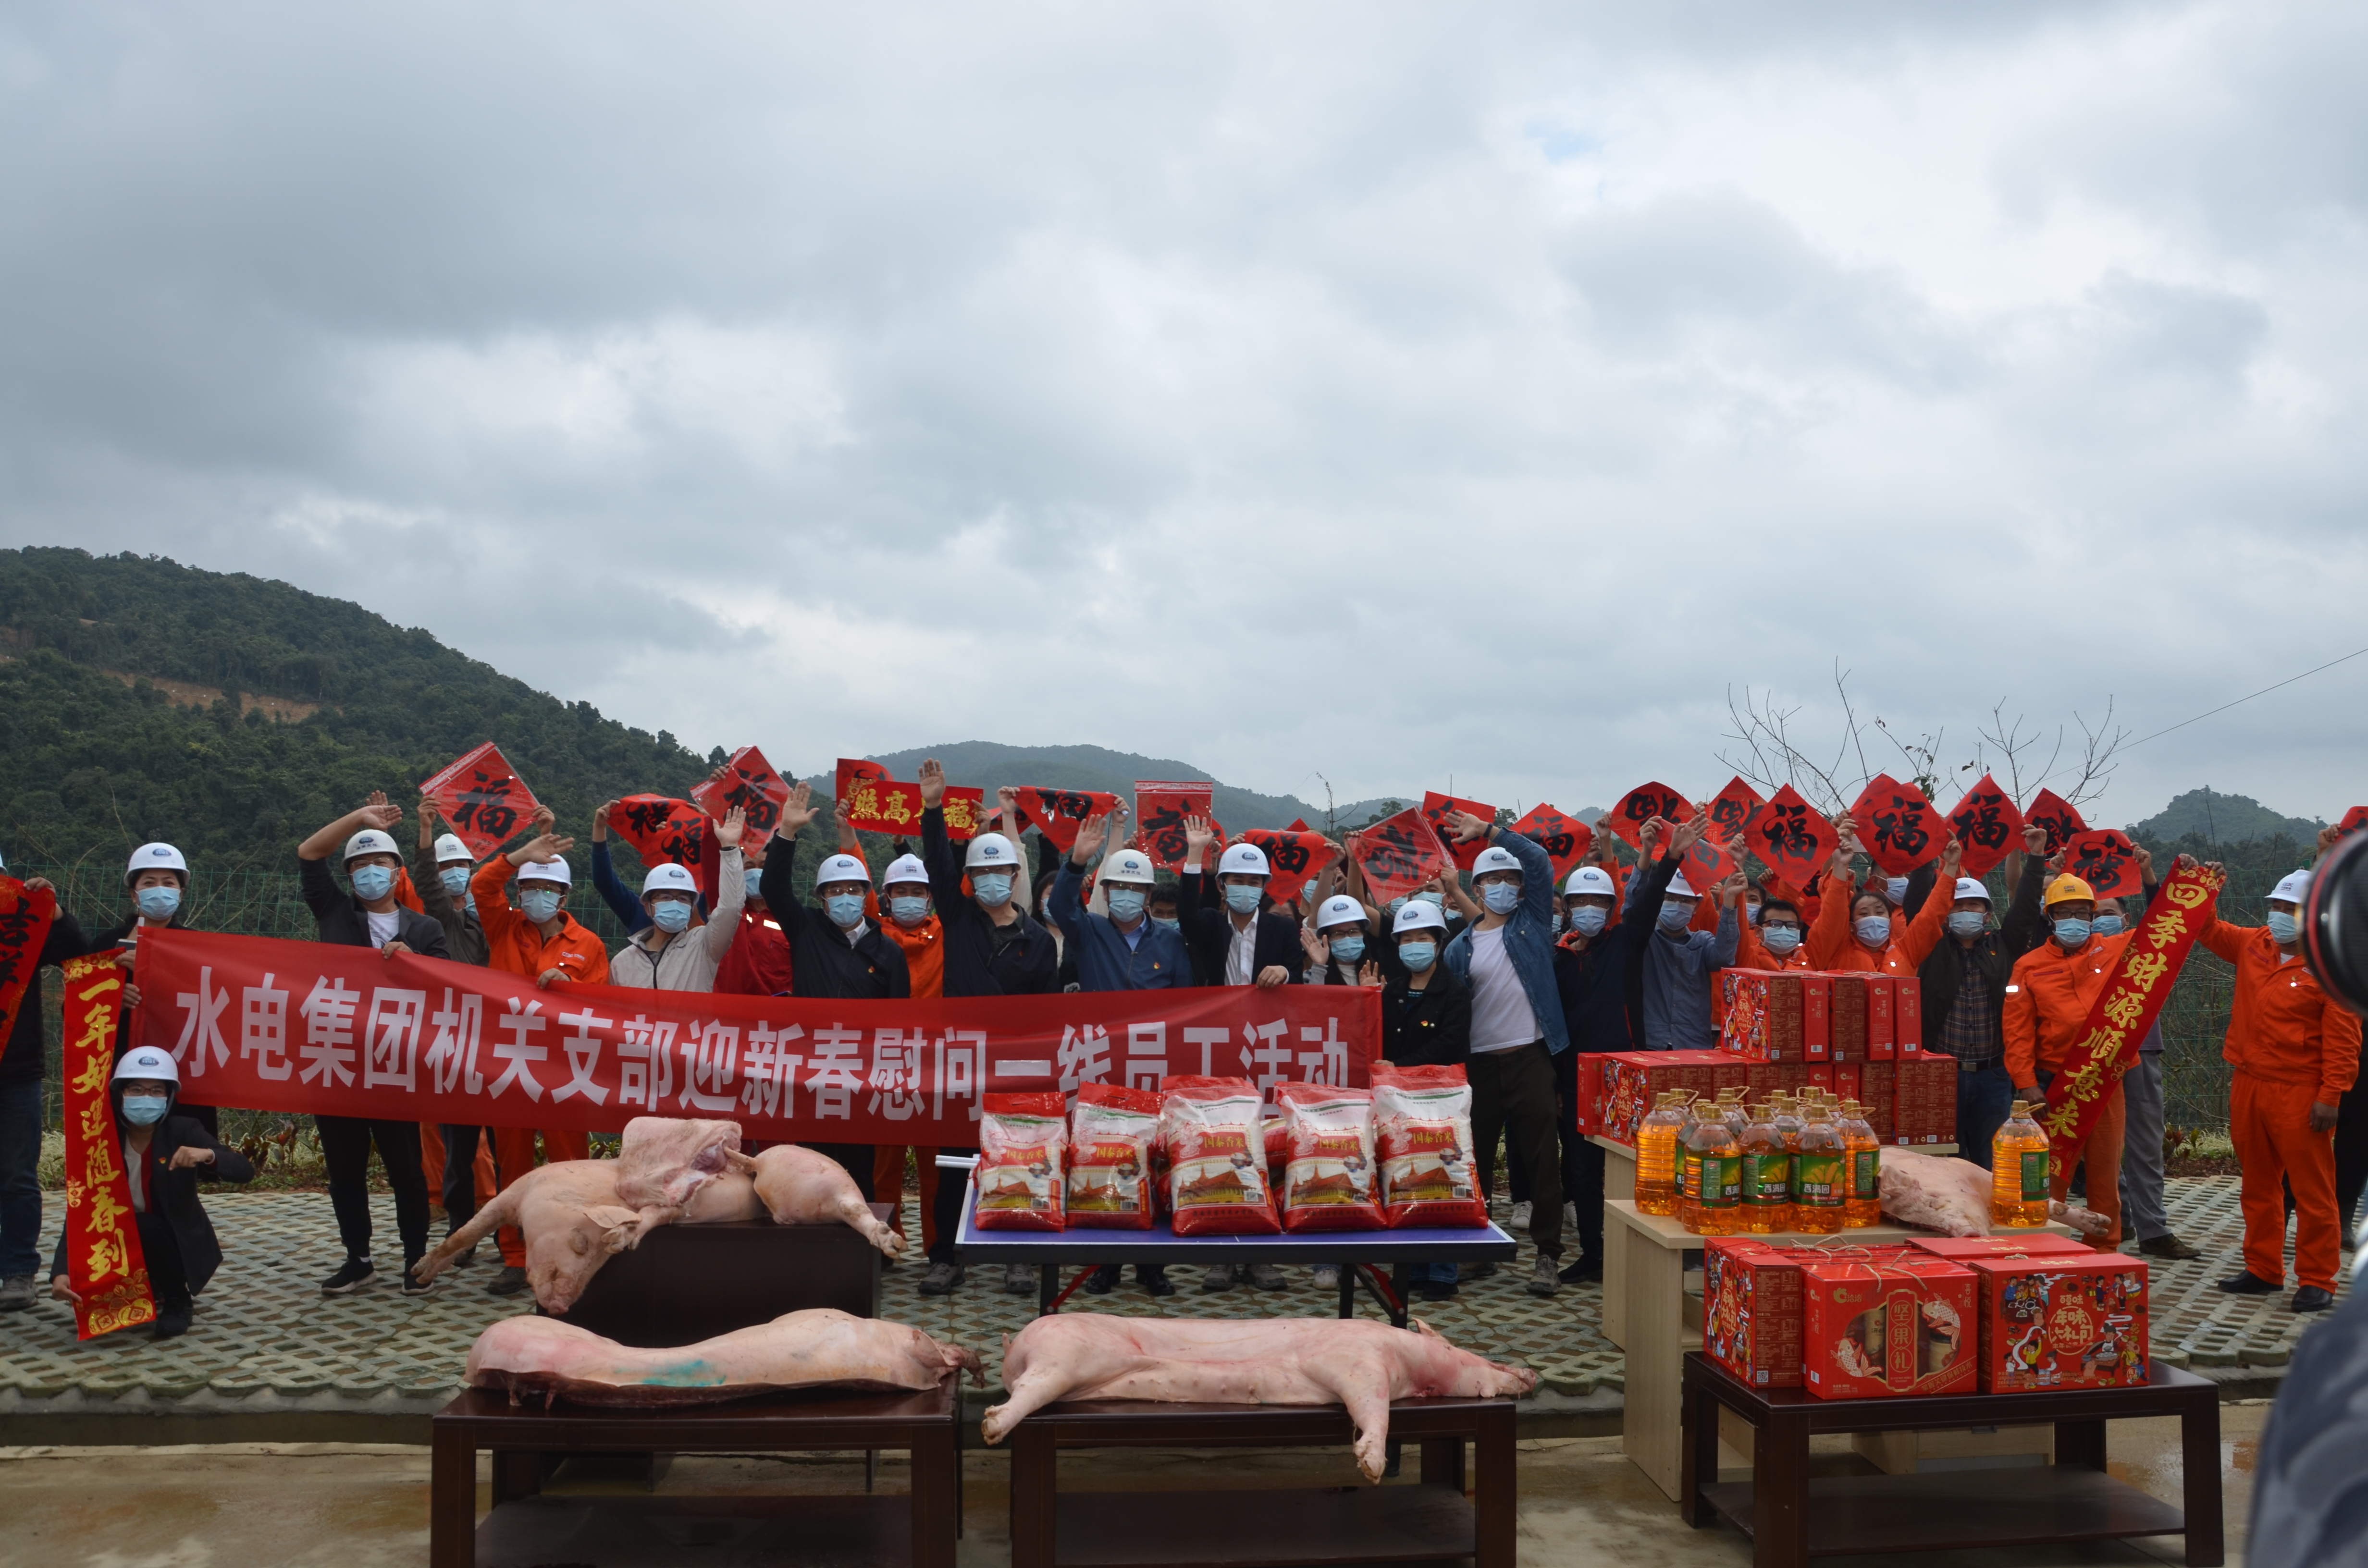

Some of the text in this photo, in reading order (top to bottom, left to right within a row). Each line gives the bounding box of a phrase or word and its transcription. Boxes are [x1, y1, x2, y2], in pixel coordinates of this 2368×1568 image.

[453, 770, 518, 838] 福
[724, 769, 778, 832] 福
[1953, 792, 2010, 850] 福
[661, 817, 702, 865] 福
[1522, 816, 1574, 858] 福
[1763, 804, 1818, 863] 福
[1873, 796, 1929, 856] 福
[1253, 834, 1309, 874] 福
[2073, 834, 2134, 892] 福
[171, 966, 1348, 1121] 水电集团机关支部迎新春慰问一线员工活动
[1007, 1149, 1043, 1160] 国泰香米
[1097, 1147, 1133, 1158] 国泰香米
[1205, 1136, 1244, 1149] 国泰香米
[1320, 1137, 1357, 1151] 国泰香米
[1414, 1131, 1453, 1144] 国泰香米
[1804, 1183, 1830, 1194] 香满园
[2056, 1308, 2087, 1325] 年味
[2060, 1294, 2084, 1305] 百草味
[1894, 1304, 1911, 1370] 坚果礼
